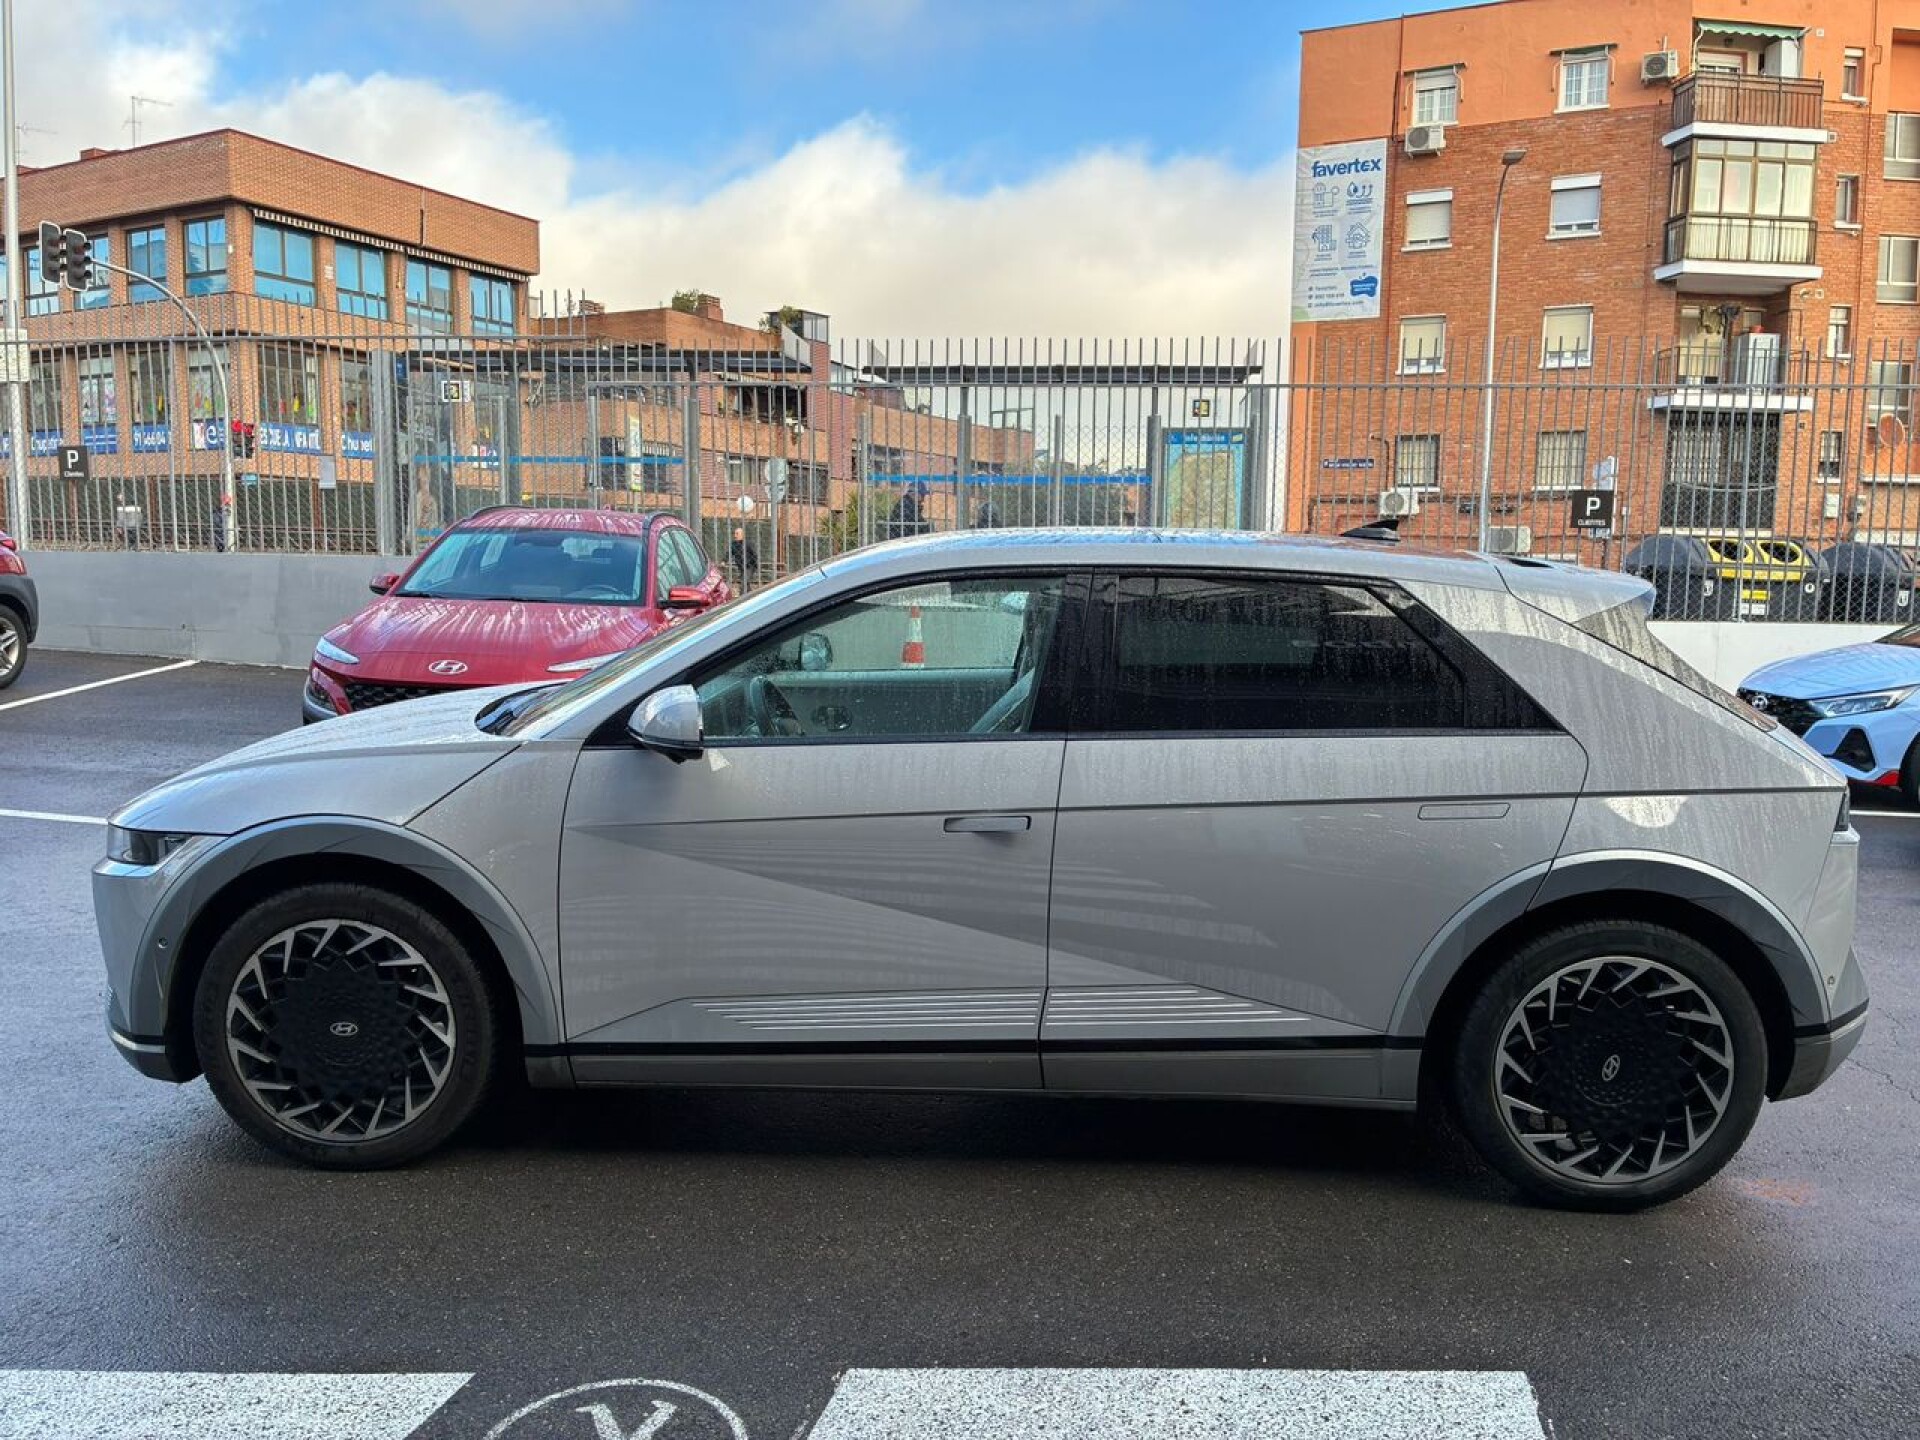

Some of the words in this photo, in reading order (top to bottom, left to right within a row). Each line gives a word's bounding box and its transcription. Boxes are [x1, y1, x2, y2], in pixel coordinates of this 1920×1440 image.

[1312, 158, 1382, 177] favertex
[67, 450, 79, 469] P
[1586, 497, 1600, 516] P
